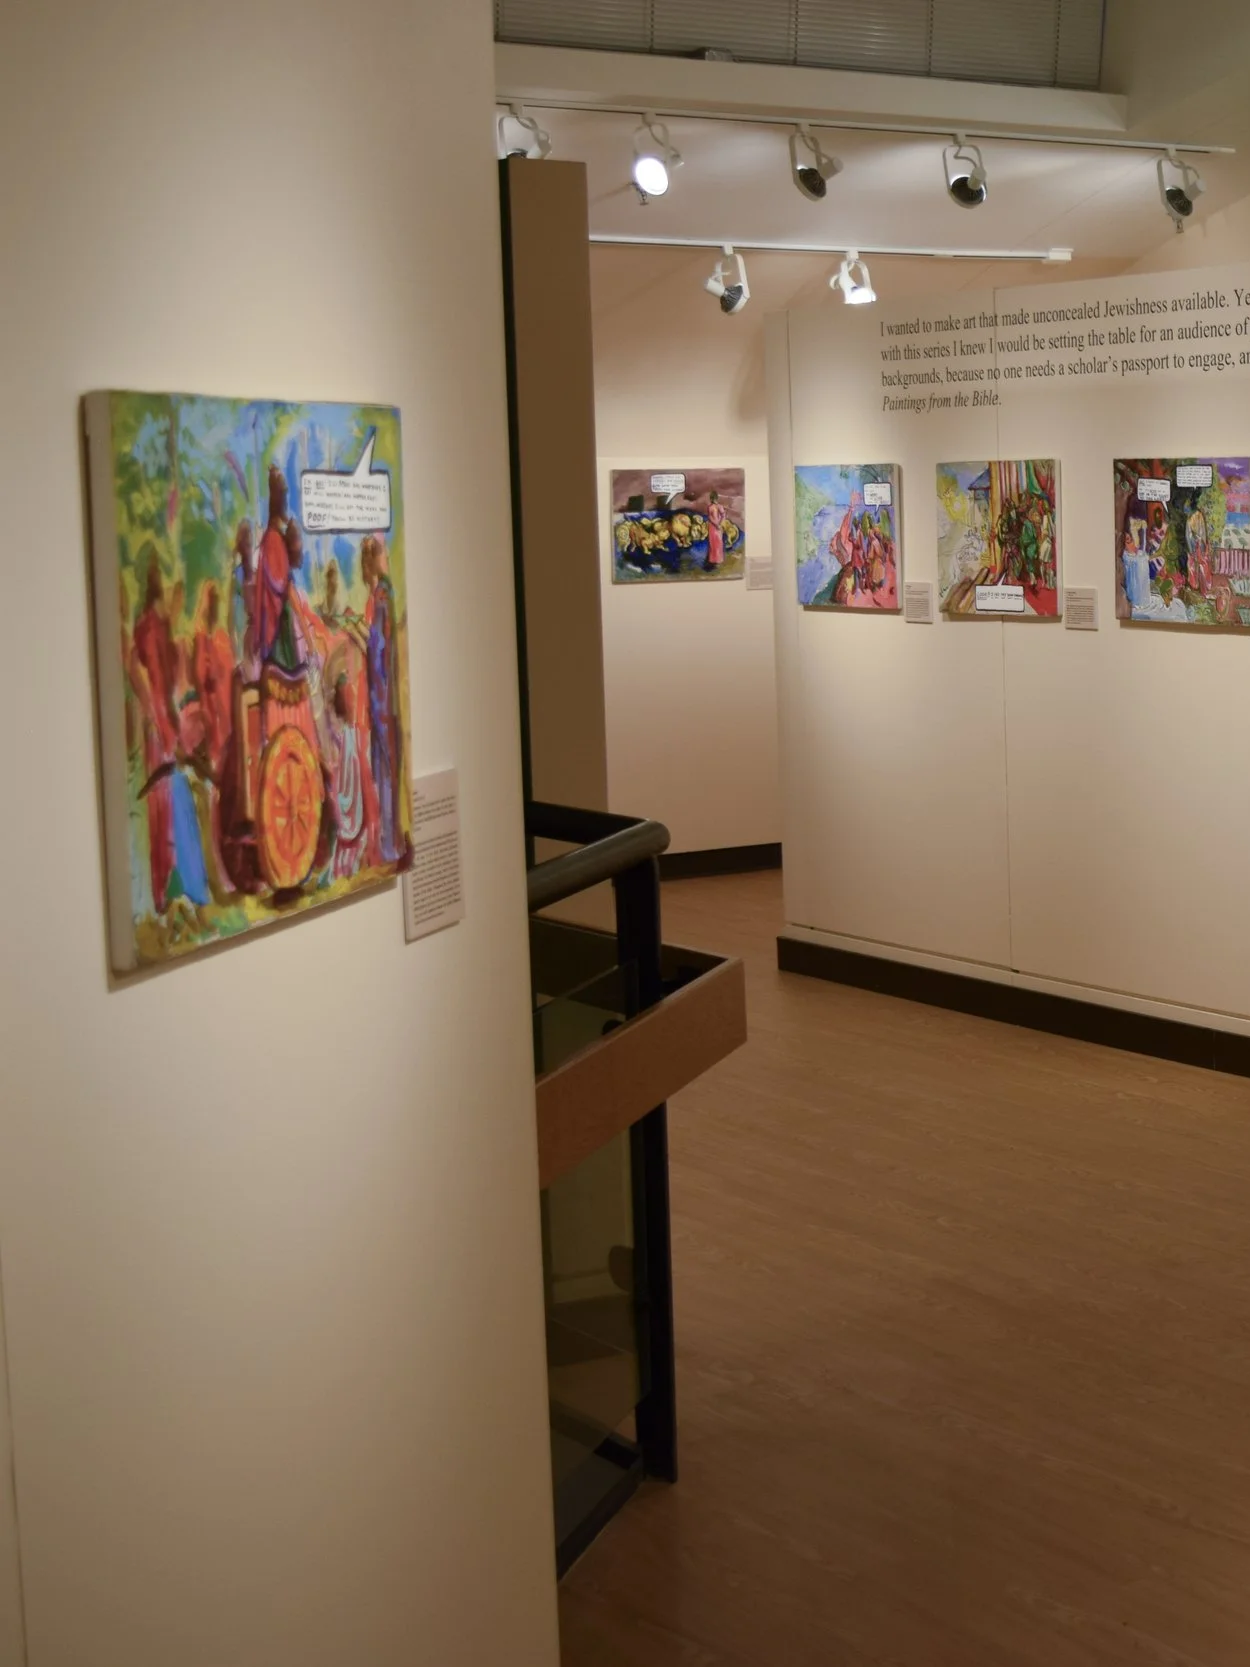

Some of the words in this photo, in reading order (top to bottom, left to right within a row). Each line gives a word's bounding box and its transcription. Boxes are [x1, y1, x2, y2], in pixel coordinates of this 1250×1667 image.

[880, 321, 884, 337] I
[887, 317, 920, 336] wanted
[922, 321, 932, 333] to
[934, 314, 961, 332] make
[963, 314, 977, 329] art
[979, 311, 998, 328] that
[1001, 307, 1030, 327] made
[1032, 300, 1100, 324] unconcealed
[1103, 297, 1168, 318] Jewishness
[1171, 291, 1230, 312] available.
[880, 344, 902, 361] with
[903, 343, 922, 360] this
[923, 340, 951, 359] series
[953, 340, 957, 357] I
[960, 339, 987, 356] knew
[989, 337, 993, 354] I
[997, 334, 1030, 353] would
[1032, 333, 1046, 351] be
[1048, 330, 1085, 352] setting
[1087, 328, 1105, 347] the
[1107, 325, 1137, 345] table
[1139, 324, 1157, 343] for
[1159, 327, 1174, 341] an
[1177, 320, 1232, 341] audience
[1234, 316, 1250, 336] of
[880, 368, 944, 390] backgrounds,
[945, 365, 985, 383] because
[987, 367, 1001, 381] no
[1003, 365, 1023, 380] one
[1025, 359, 1056, 378] needs
[1058, 363, 1065, 376] a
[1121, 354, 1170, 377] passport
[1173, 354, 1185, 369] to
[1188, 351, 1236, 372] engage,
[882, 394, 927, 414] Paintings
[926, 392, 952, 414] from
[954, 391, 970, 408] the
[972, 389, 1002, 408] Bible.
